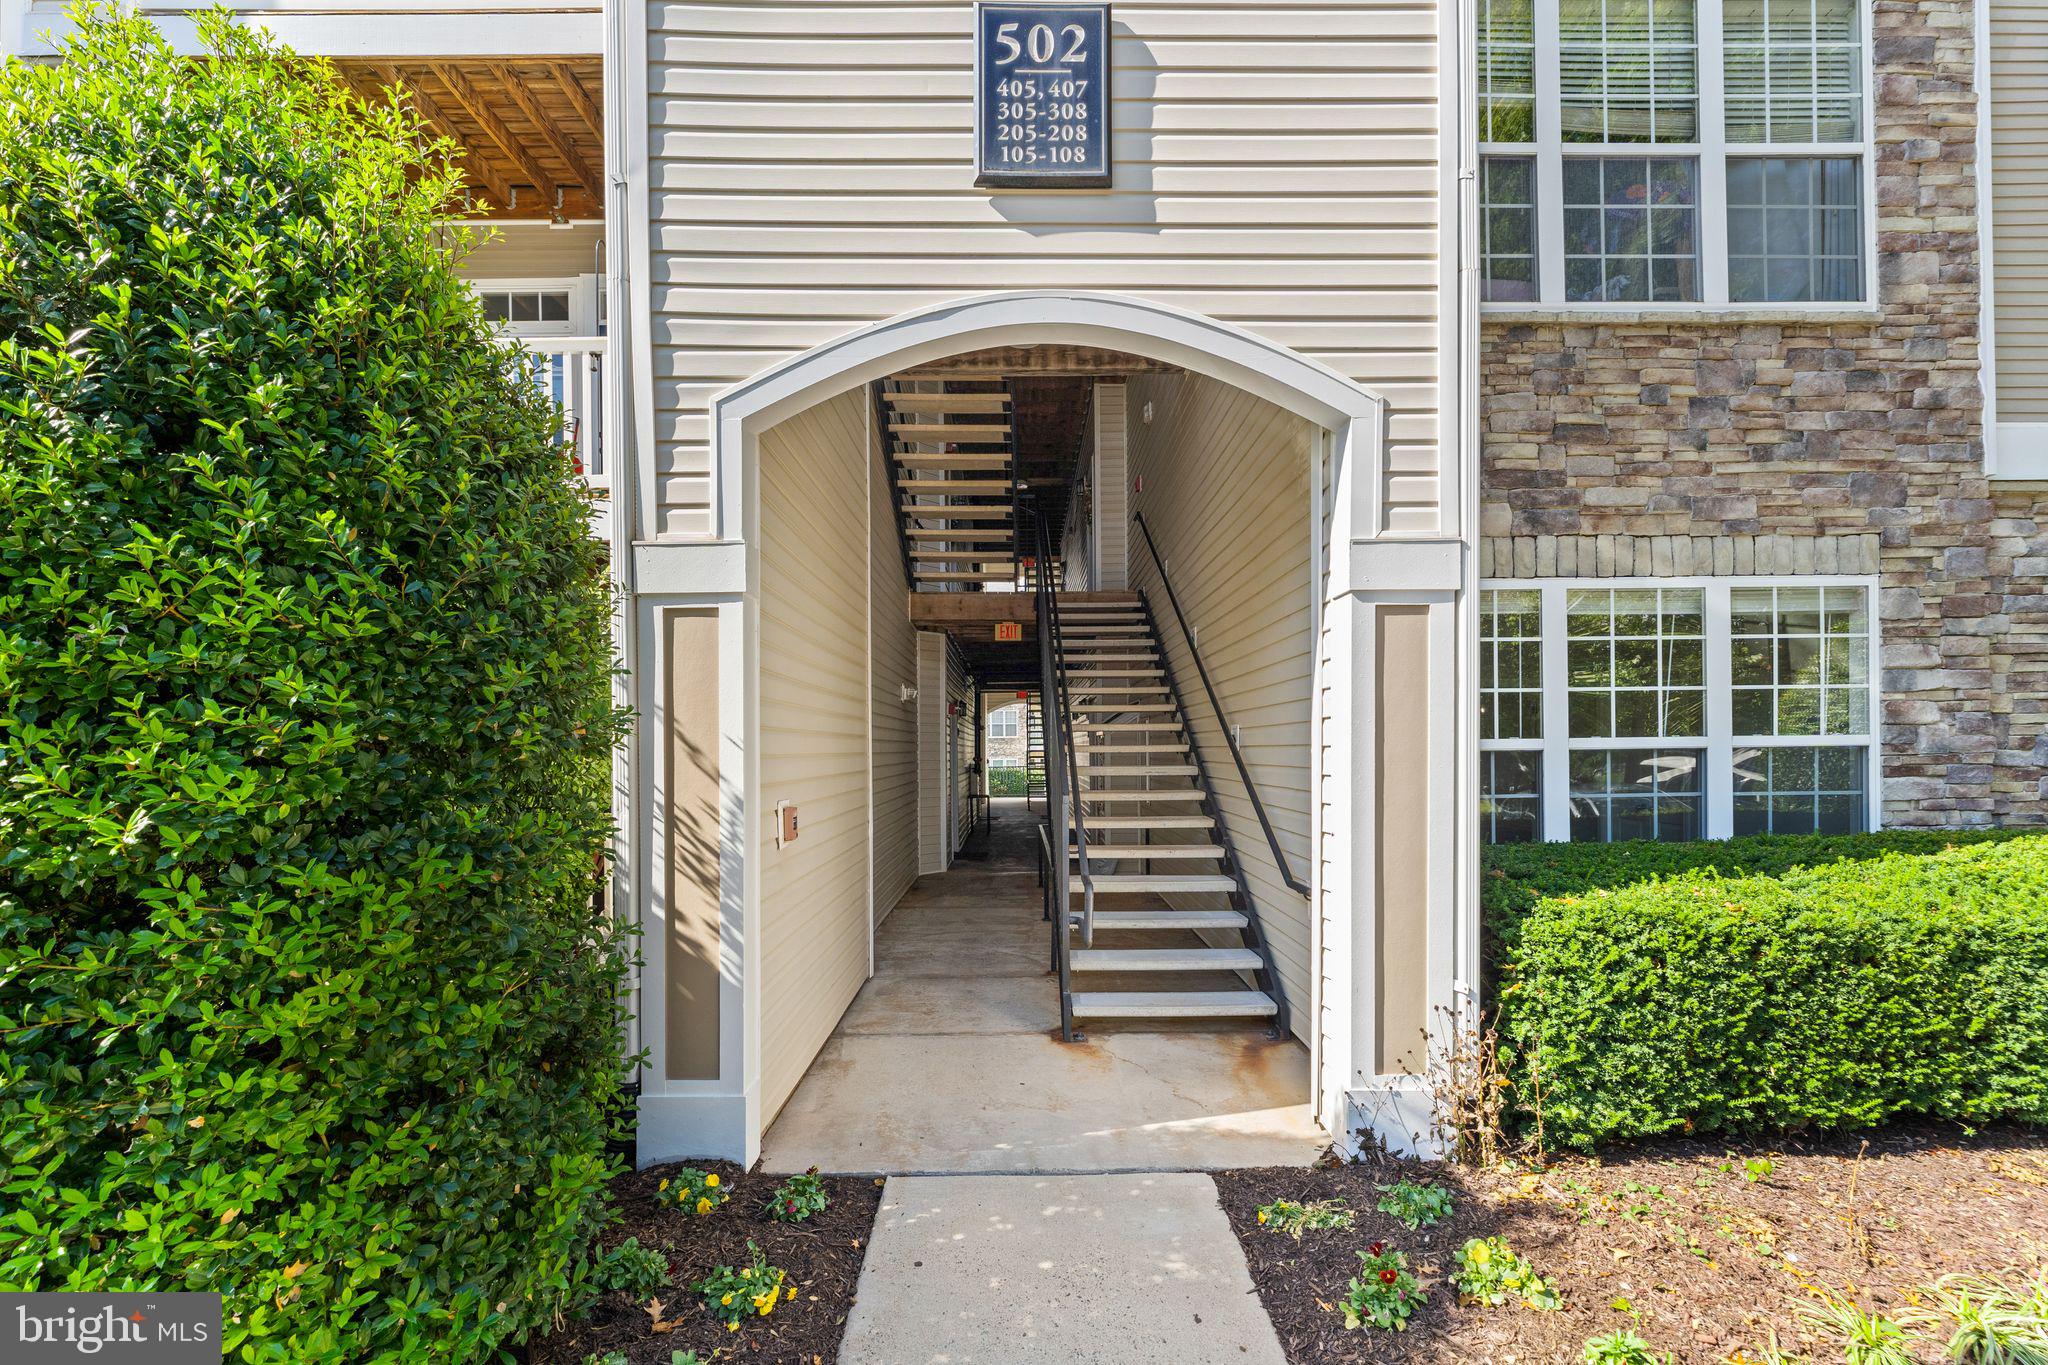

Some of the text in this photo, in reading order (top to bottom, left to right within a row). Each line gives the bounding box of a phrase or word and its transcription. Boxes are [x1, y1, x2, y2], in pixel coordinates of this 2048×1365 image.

[995, 22, 1088, 65] 502
[997, 102, 1088, 120] 305-308
[997, 124, 1087, 142] 205-208
[1001, 146, 1086, 164] 105-108
[999, 623, 1018, 639] EXIT
